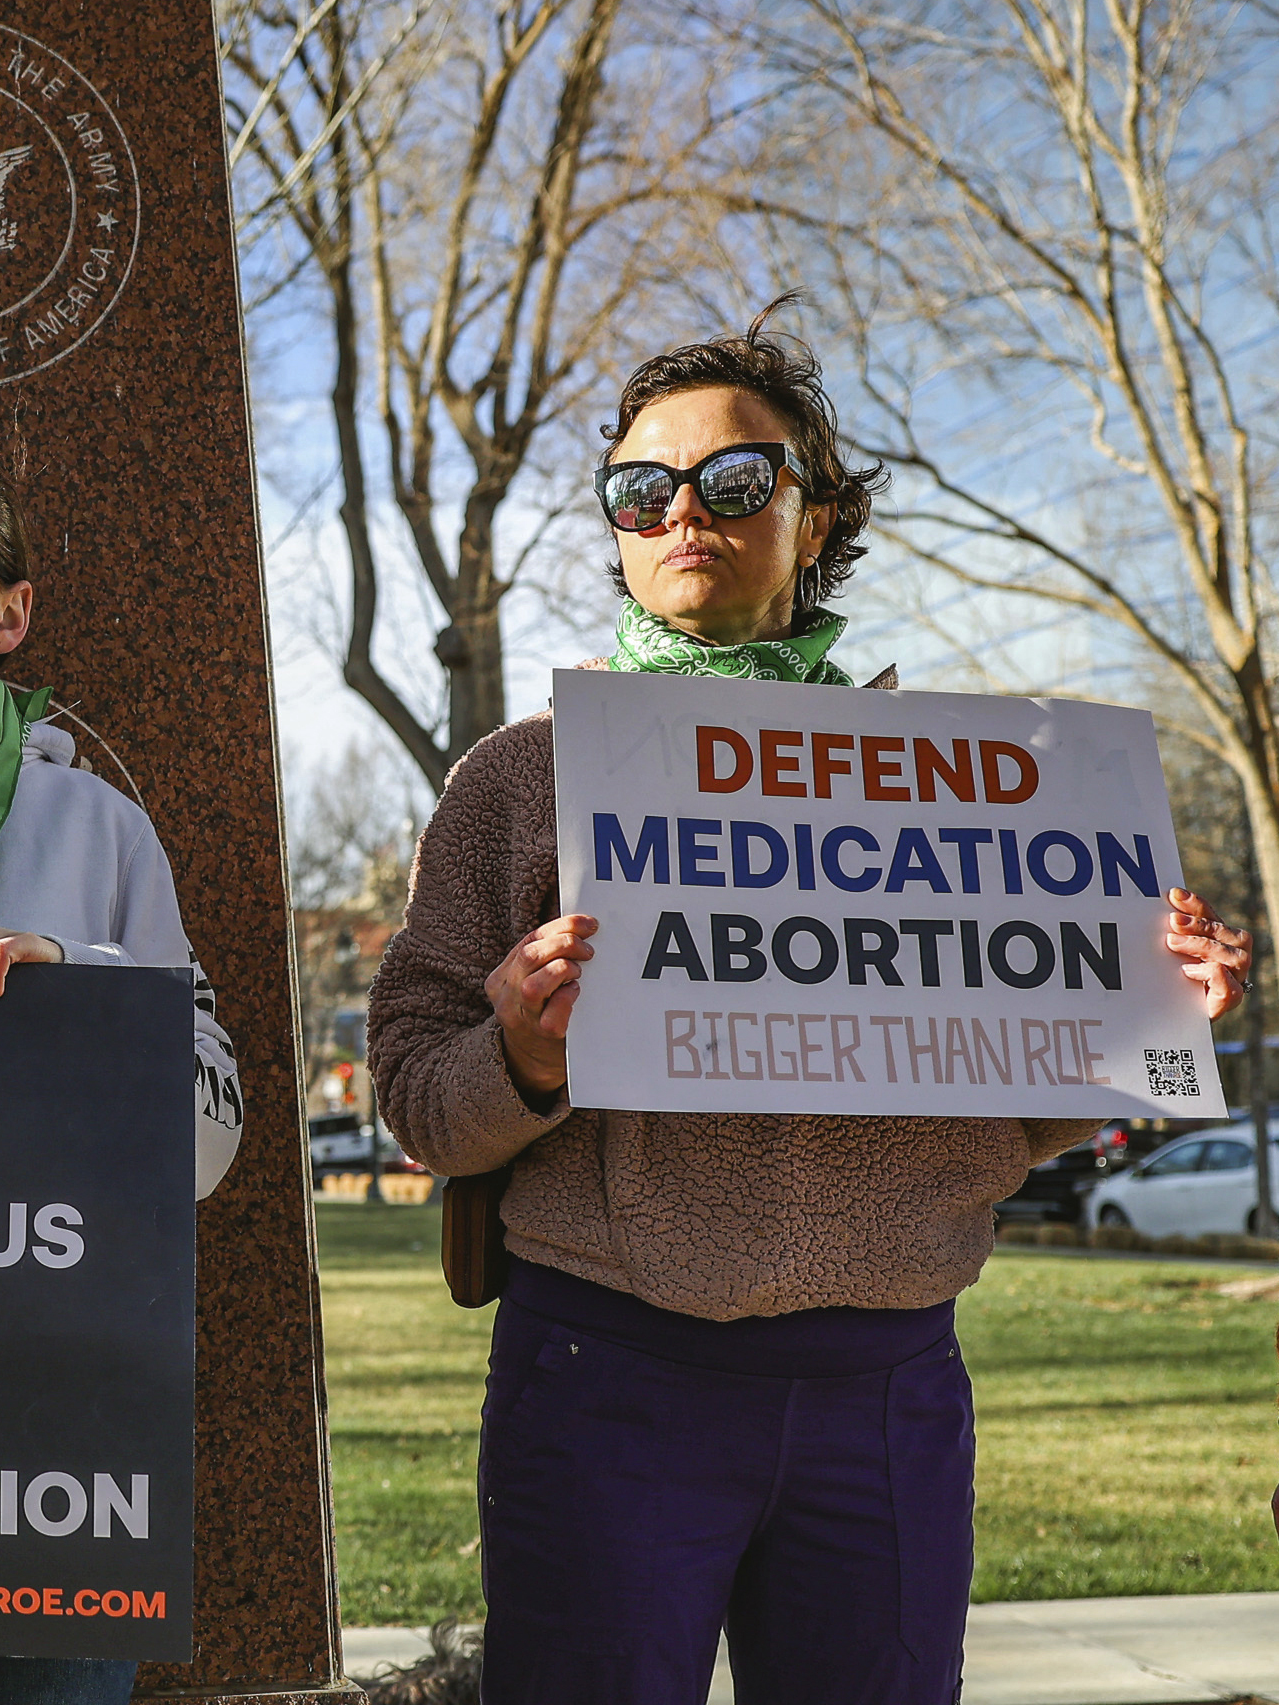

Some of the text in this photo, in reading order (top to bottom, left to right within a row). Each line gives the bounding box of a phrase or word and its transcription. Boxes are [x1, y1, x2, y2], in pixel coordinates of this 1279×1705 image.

[8, 49, 66, 100] THE
[67, 111, 120, 193] ARMY
[24, 247, 115, 350] AMERICA
[696, 725, 1039, 803] DEFEND
[593, 812, 1161, 897] MEDICATION
[641, 911, 1123, 991] ABORTION
[665, 1009, 1113, 1086] BIGGER THAN ROE
